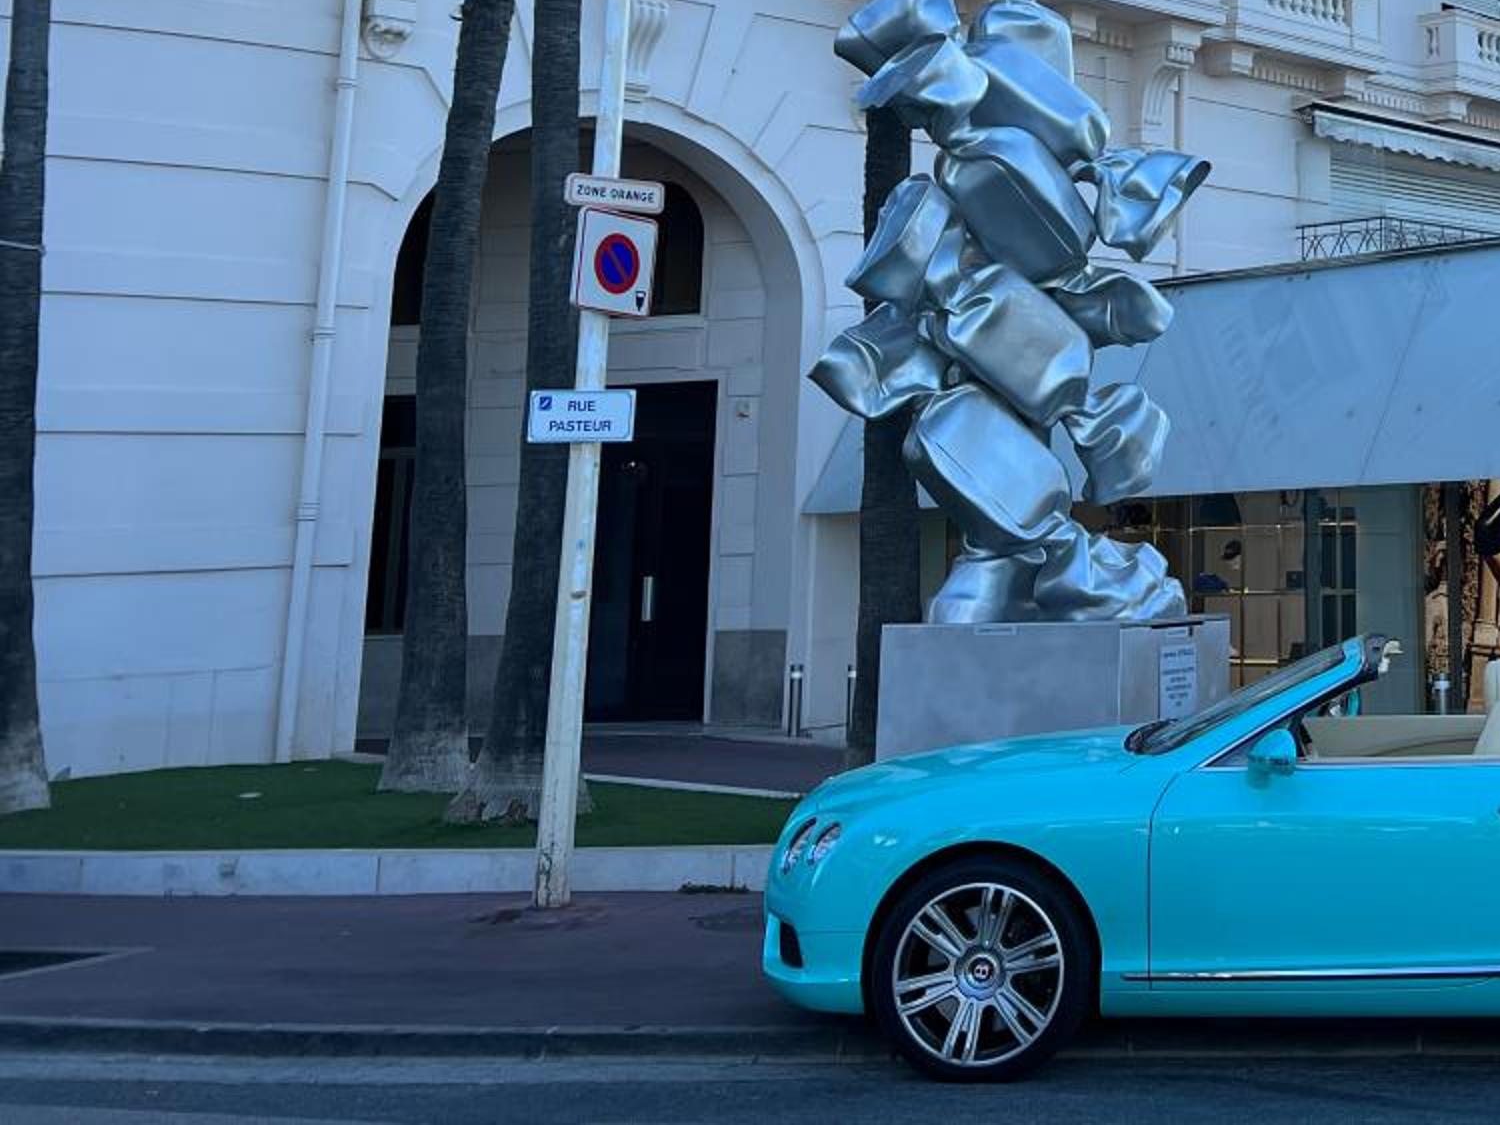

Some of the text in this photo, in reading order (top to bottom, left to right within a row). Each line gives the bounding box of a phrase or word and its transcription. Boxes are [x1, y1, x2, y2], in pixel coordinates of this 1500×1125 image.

[576, 184, 655, 203] ZONE ORANGE
[567, 400, 596, 412] RUE
[549, 420, 611, 432] PASTEUR
